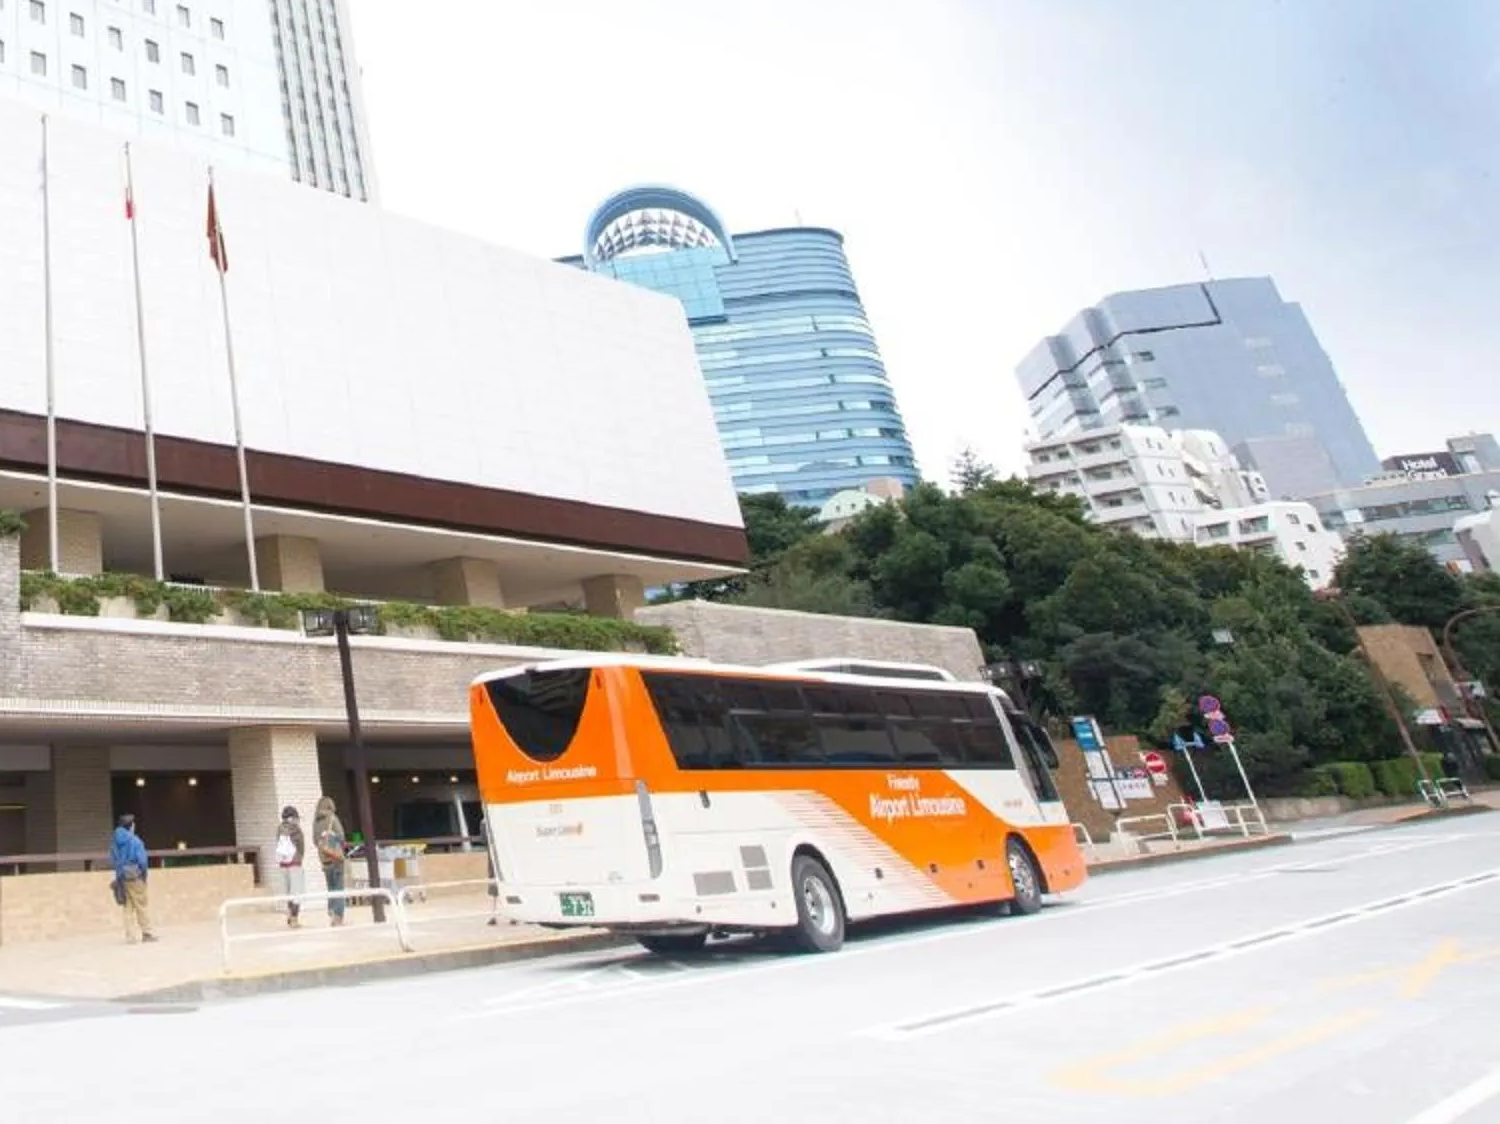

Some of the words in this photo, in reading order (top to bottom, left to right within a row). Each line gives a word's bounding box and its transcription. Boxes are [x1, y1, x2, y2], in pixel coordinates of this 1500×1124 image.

[1401, 456, 1438, 470] Hotel
[869, 793, 910, 826] Airport
[909, 792, 968, 817] Limousine
